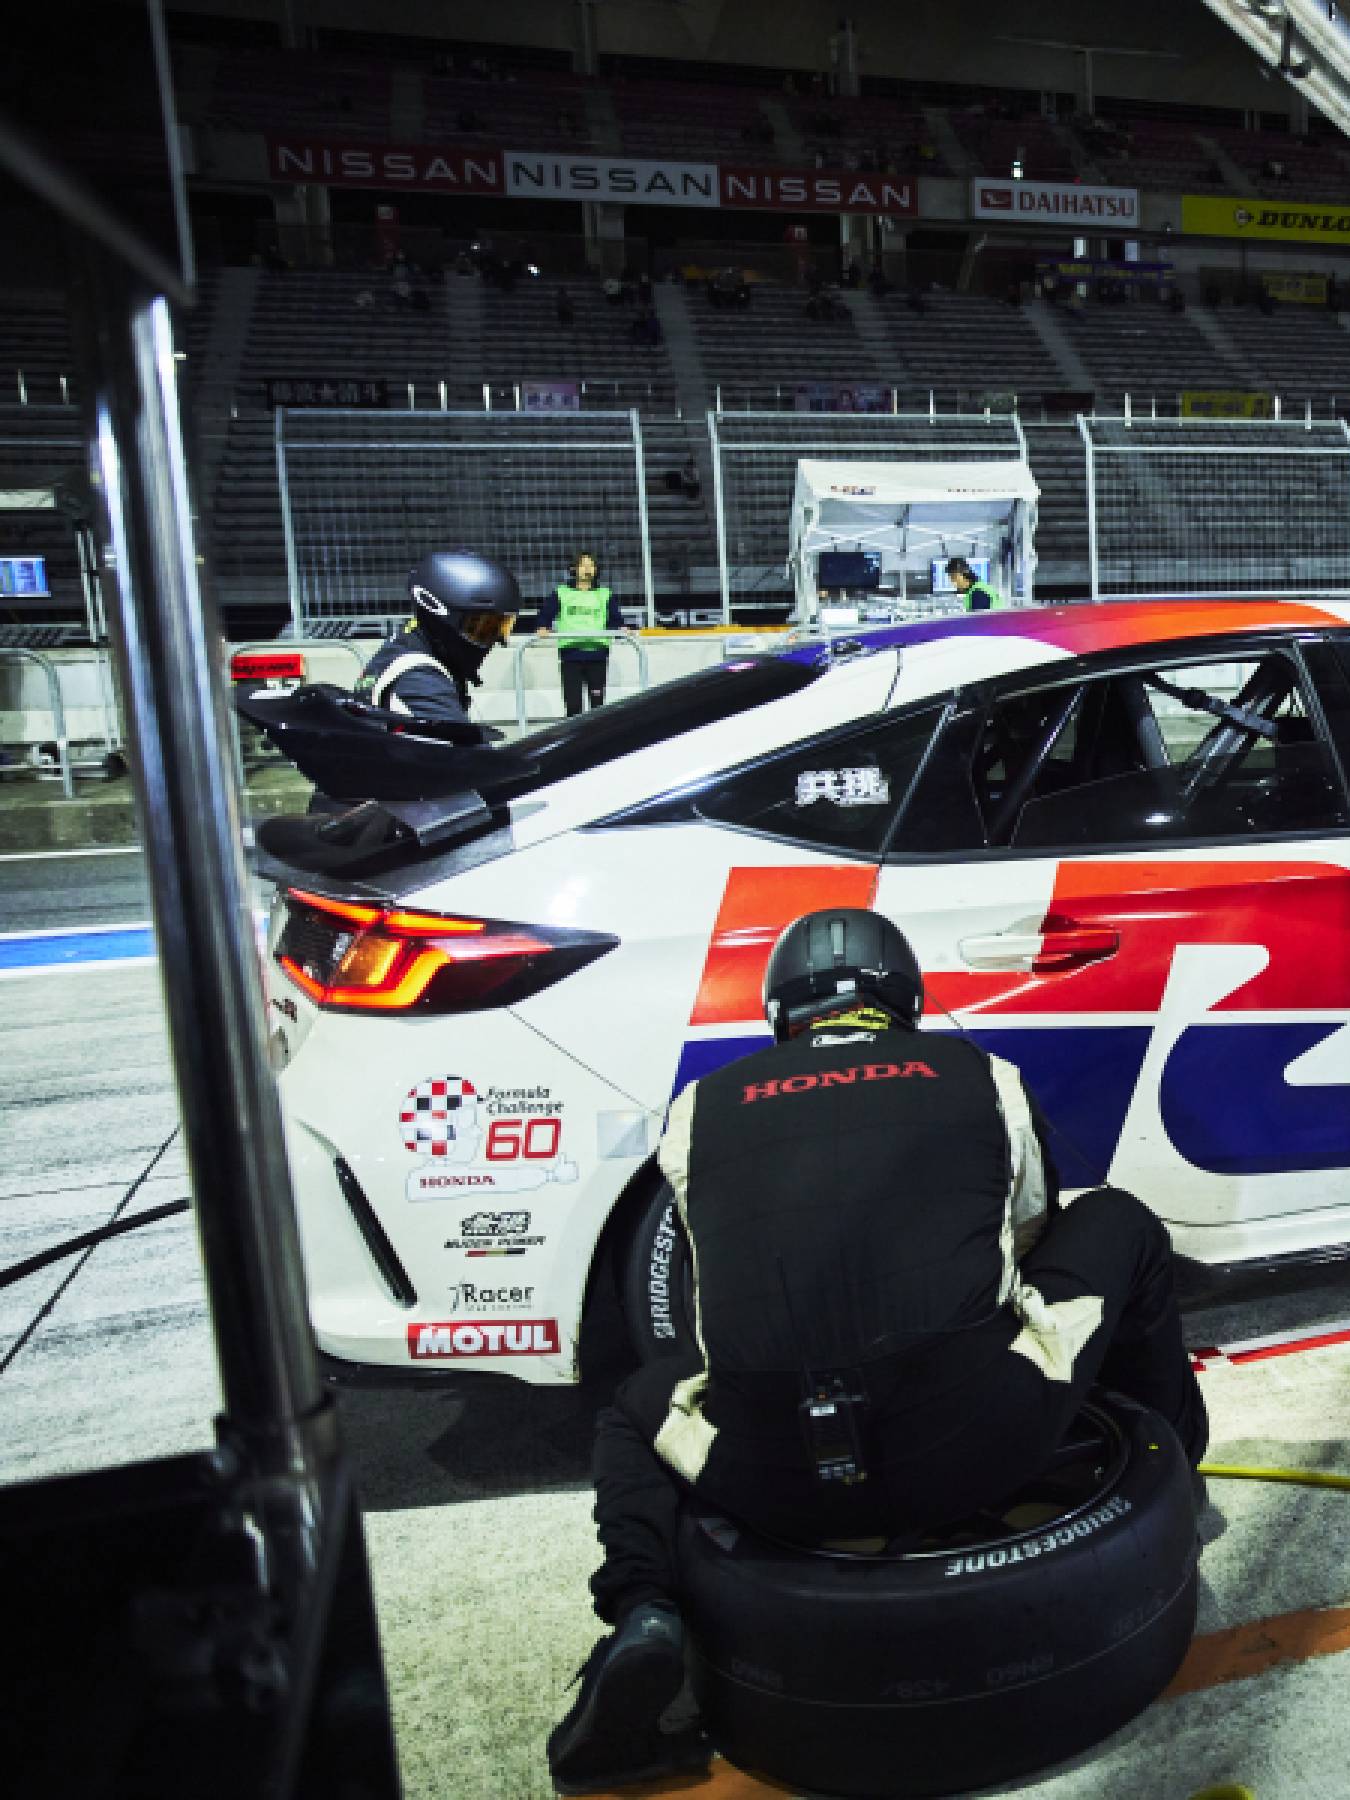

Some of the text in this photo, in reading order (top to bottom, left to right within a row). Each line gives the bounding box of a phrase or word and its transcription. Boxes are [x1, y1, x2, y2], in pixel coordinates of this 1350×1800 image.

[277, 146, 498, 185] NISSAN
[512, 160, 713, 198] NISSAN
[725, 175, 912, 210] NISSAN
[1018, 189, 1136, 219] DAIHATSU
[741, 1060, 939, 1104] HONDA
[486, 1118, 562, 1161] 60
[420, 1175, 496, 1188] HONDA
[651, 1204, 676, 1338] BRIDGEST
[416, 1325, 553, 1354] MOTUL
[944, 1496, 1133, 1577] BRIDGESTONE
